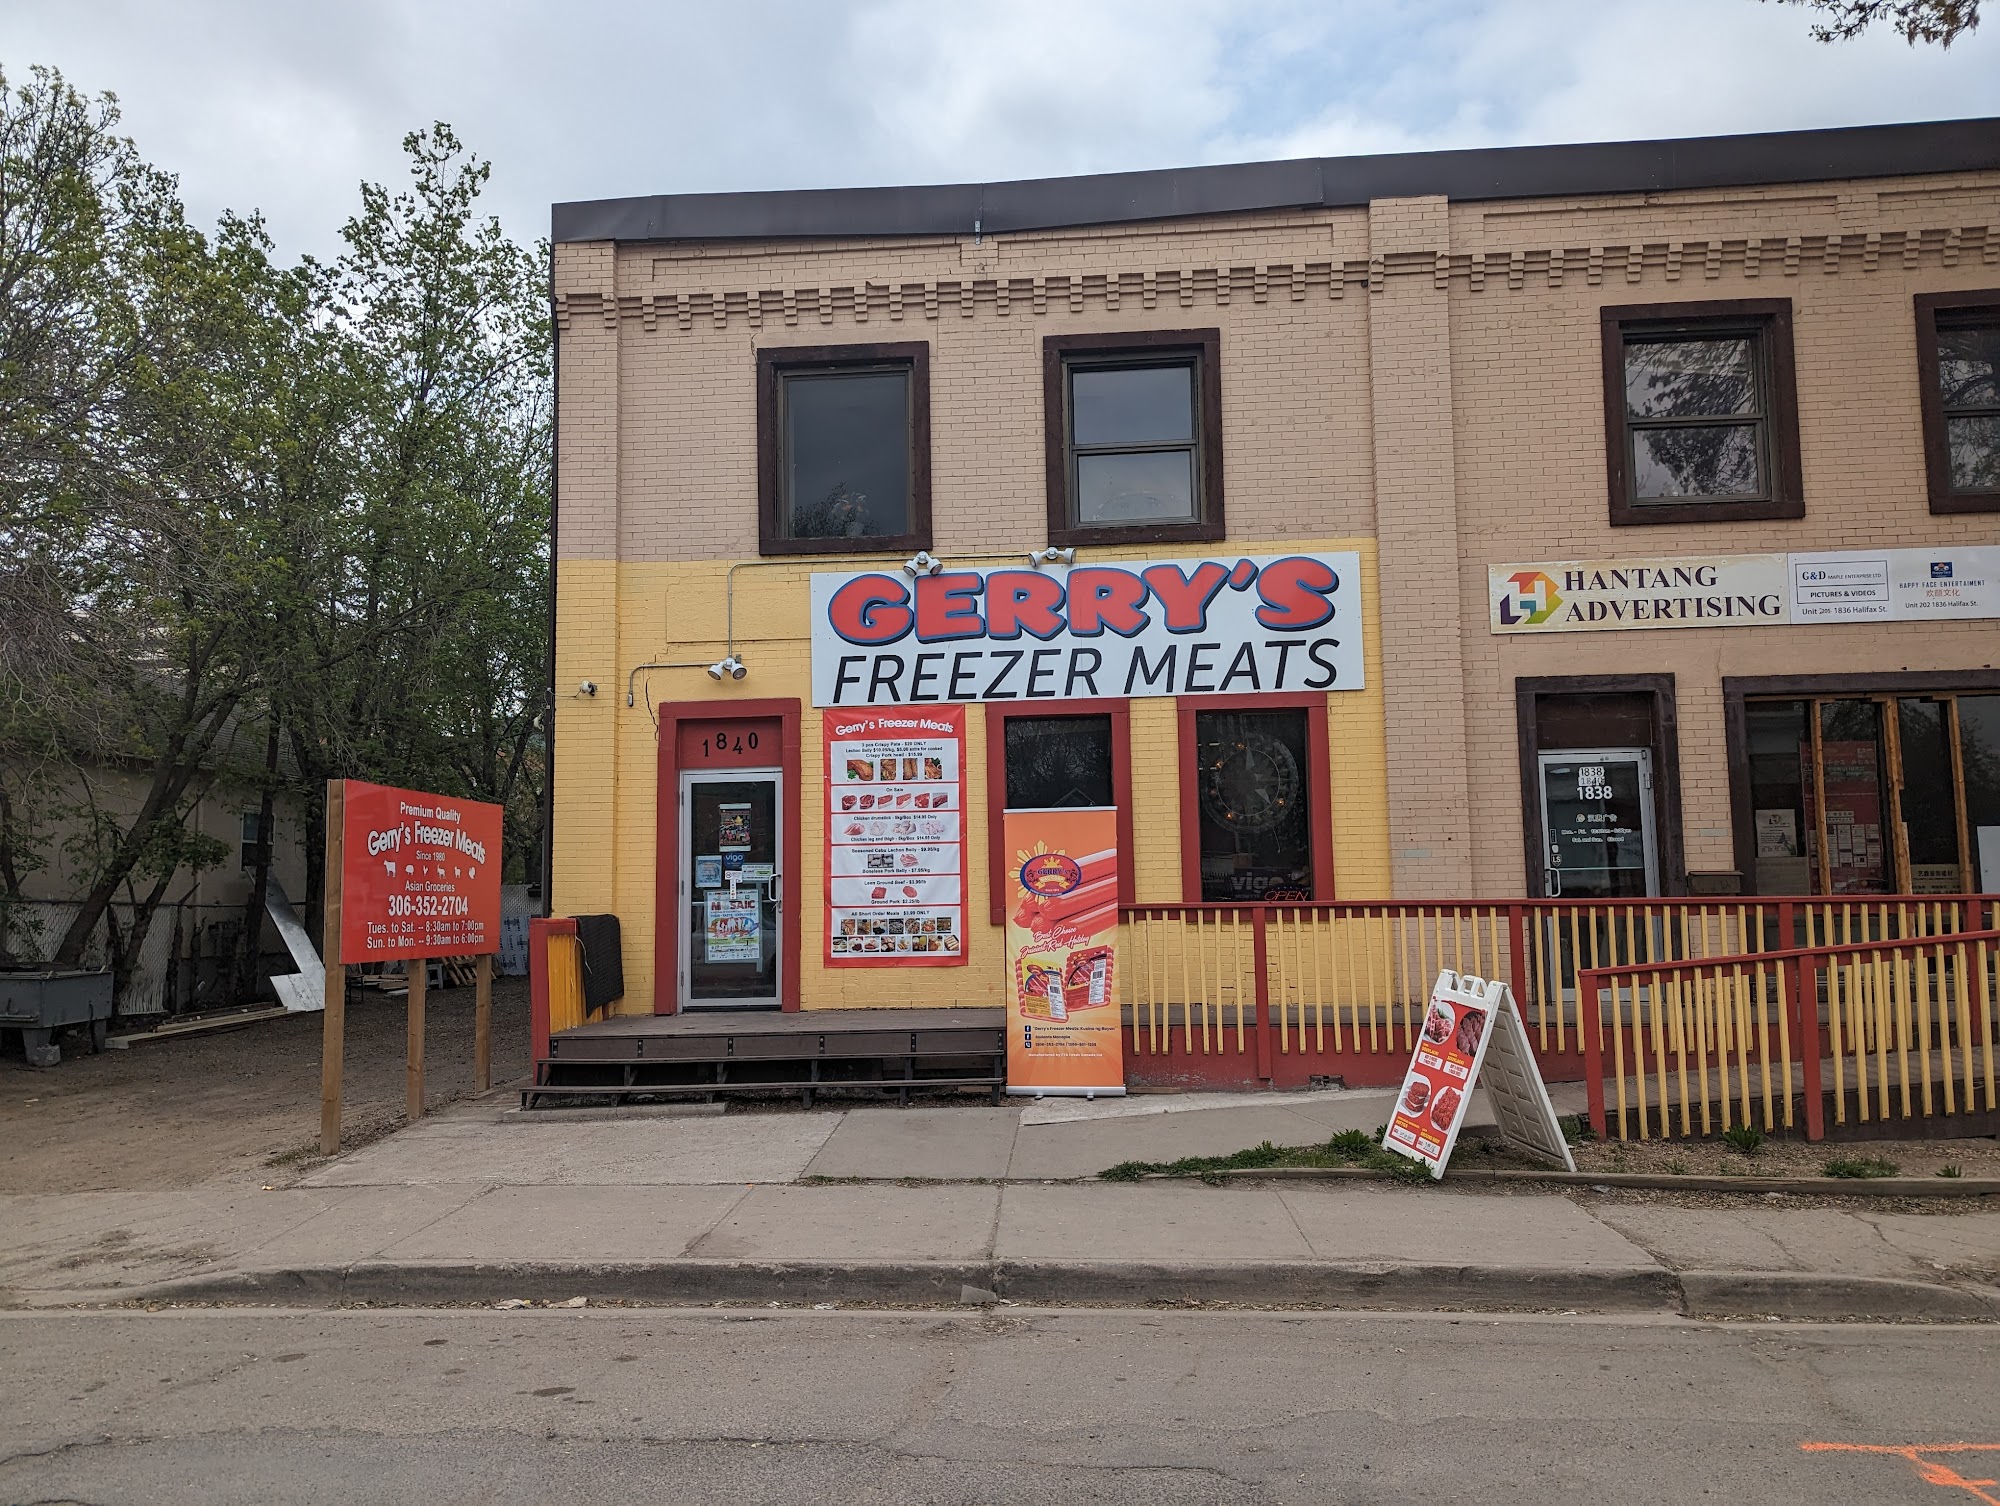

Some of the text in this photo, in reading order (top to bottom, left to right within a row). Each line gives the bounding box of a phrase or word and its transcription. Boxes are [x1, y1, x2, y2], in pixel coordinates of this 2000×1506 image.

[1564, 565, 1719, 592] HANTANG
[1802, 570, 1827, 581] G&D
[1899, 581, 1919, 589] HAPPY
[1940, 580, 1985, 588] ENTERTAIMENT
[828, 556, 1340, 645] GERRY'S
[1810, 590, 1842, 598] PICTURES
[1851, 589, 1876, 597] VIDEOS
[1565, 594, 1782, 622] ADVERTISING
[1802, 607, 1818, 616] Unit
[1834, 606, 1852, 614] 1836
[1853, 605, 1878, 614] Halifax
[1879, 605, 1888, 613] St.
[832, 638, 1340, 704] FREEZER MEATS
[835, 718, 954, 736] Gerry's Freezer Meats
[703, 732, 759, 757] 1840
[1581, 767, 1603, 776] 1838
[1576, 785, 1613, 800] 1838
[400, 801, 462, 824] Premium Quality
[367, 820, 486, 865] Gerry's Freezer Meats
[416, 850, 431, 861] Since
[726, 853, 743, 862] vigo
[405, 880, 455, 893] Asian Groceries
[1264, 890, 1309, 901] OPEN
[388, 895, 468, 916] 306-352-2704
[367, 922, 389, 934] Tues.
[391, 923, 399, 933] to
[401, 921, 416, 933] Sat.
[425, 920, 451, 932] 8:30am
[453, 921, 459, 931] to
[461, 920, 484, 934] 7:00pm
[1034, 926, 1077, 942] Best Choice
[367, 937, 385, 949] Sun.
[387, 938, 395, 948] to
[398, 936, 416, 948] Mon.
[425, 934, 451, 946] 9:30am
[453, 935, 460, 945] to
[461, 933, 485, 946] 6:00pm
